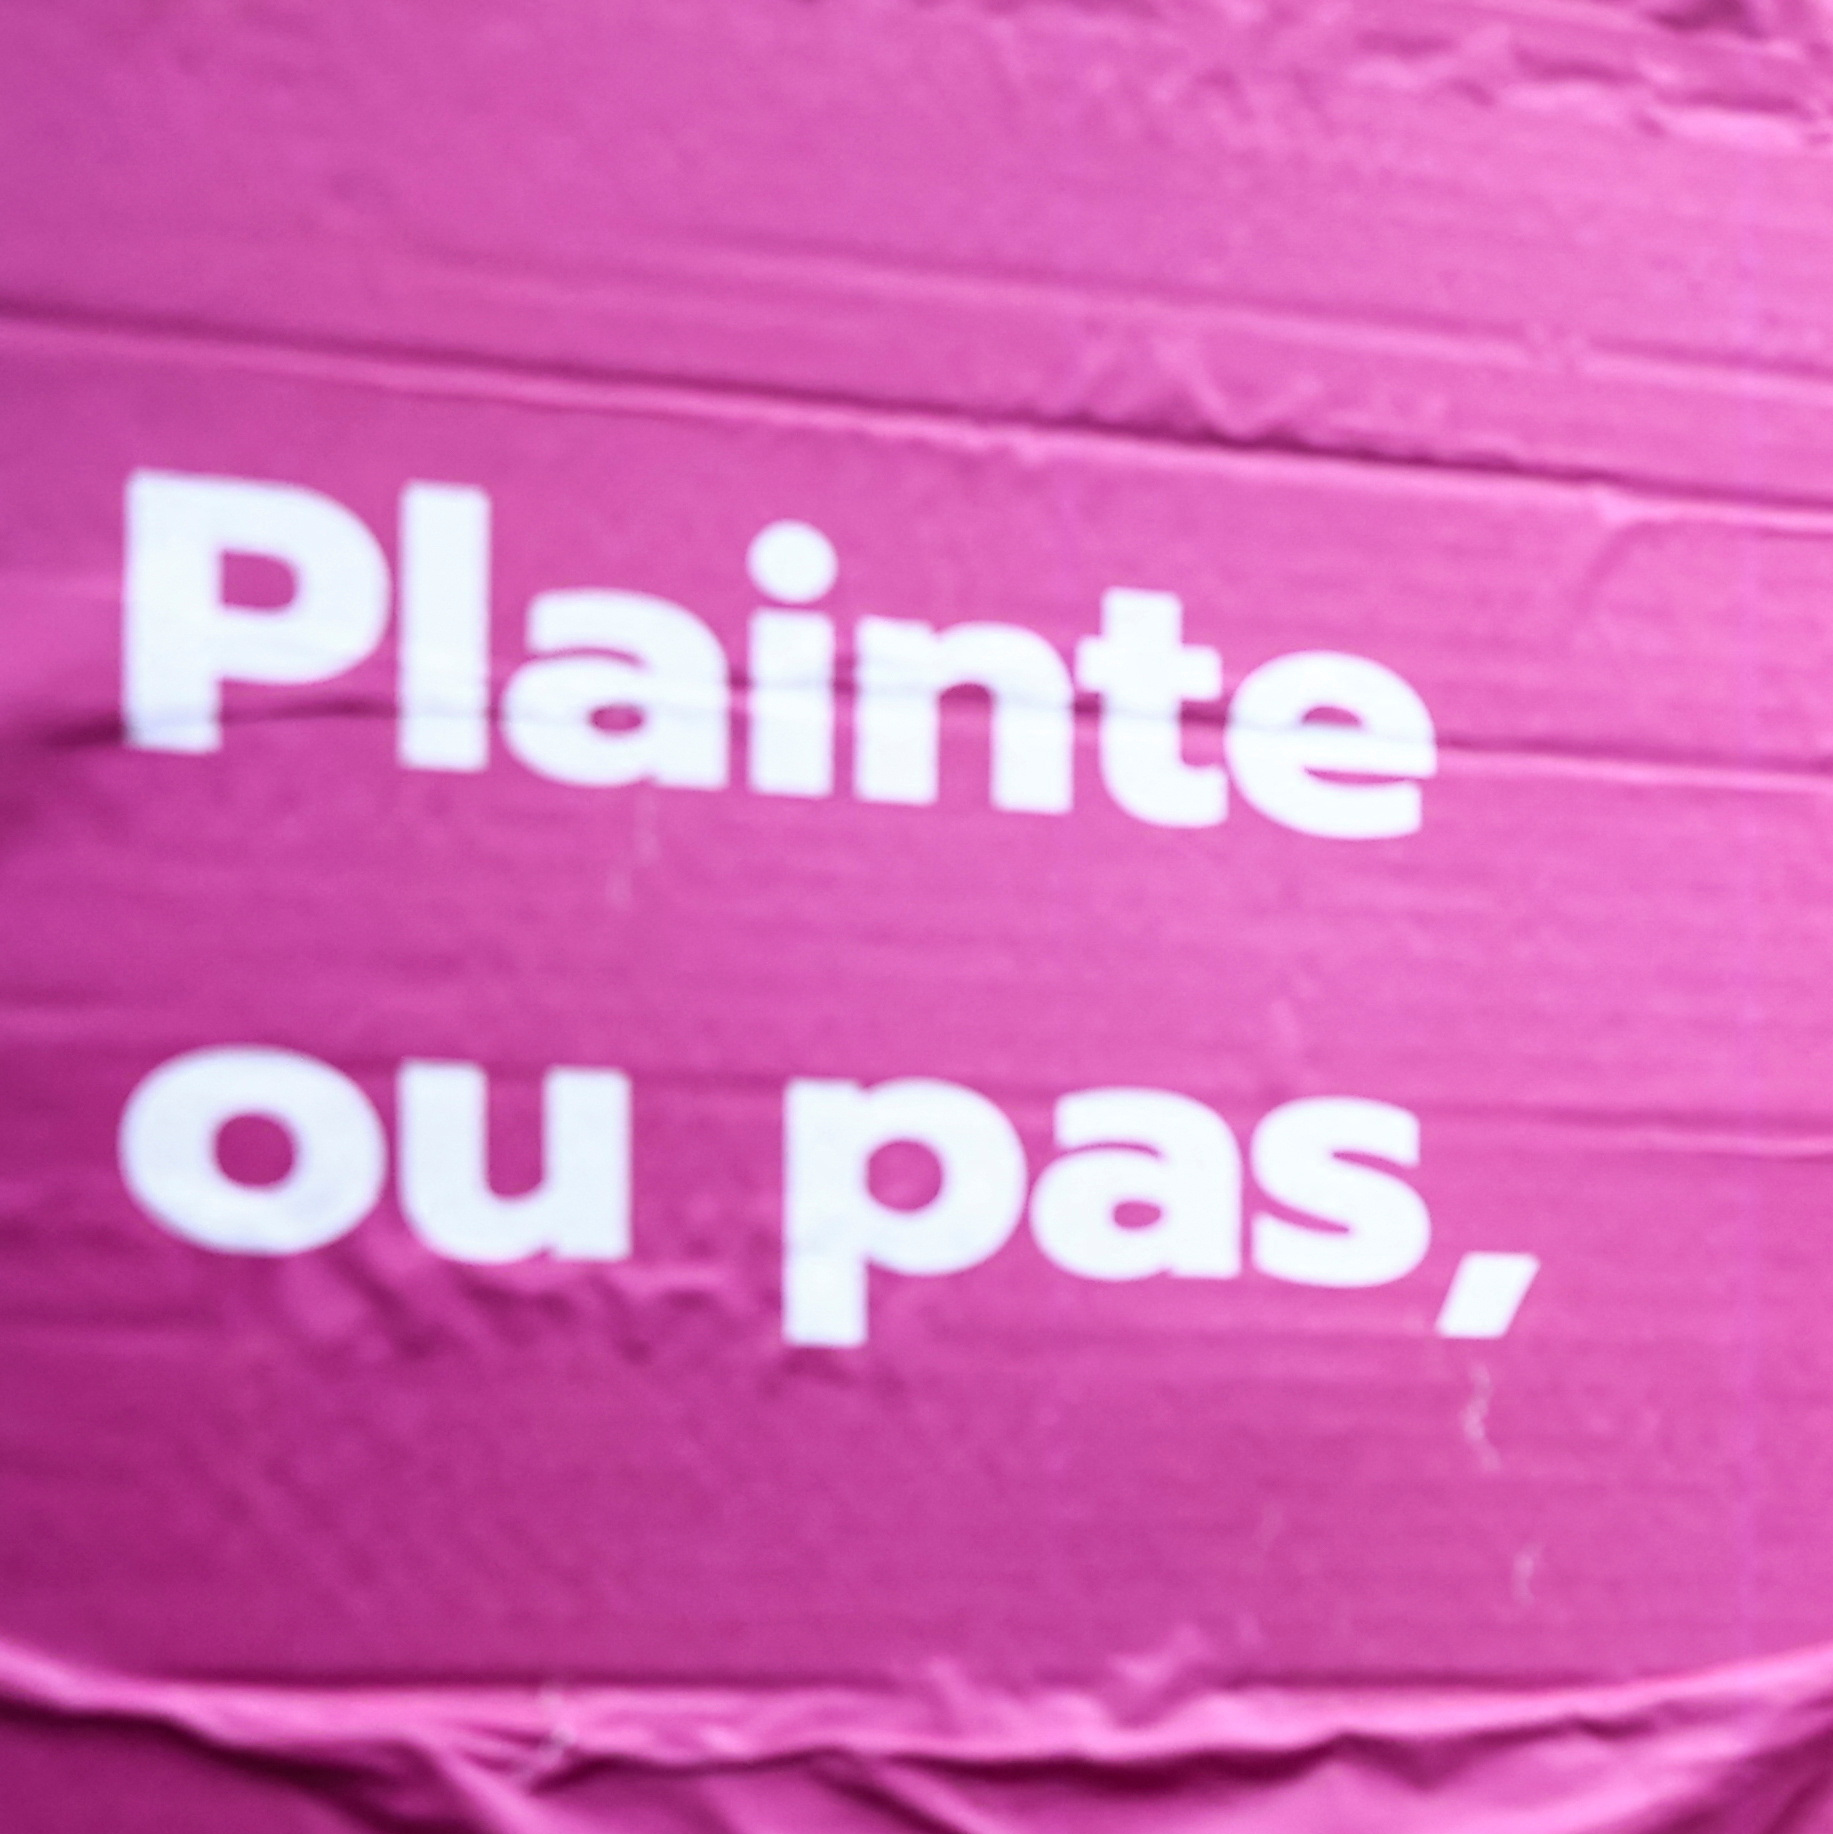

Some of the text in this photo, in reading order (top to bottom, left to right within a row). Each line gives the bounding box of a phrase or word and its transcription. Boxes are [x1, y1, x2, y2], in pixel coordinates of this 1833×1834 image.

[123, 471, 1439, 840] Plainte
[122, 1048, 1541, 1347] ou pas,
